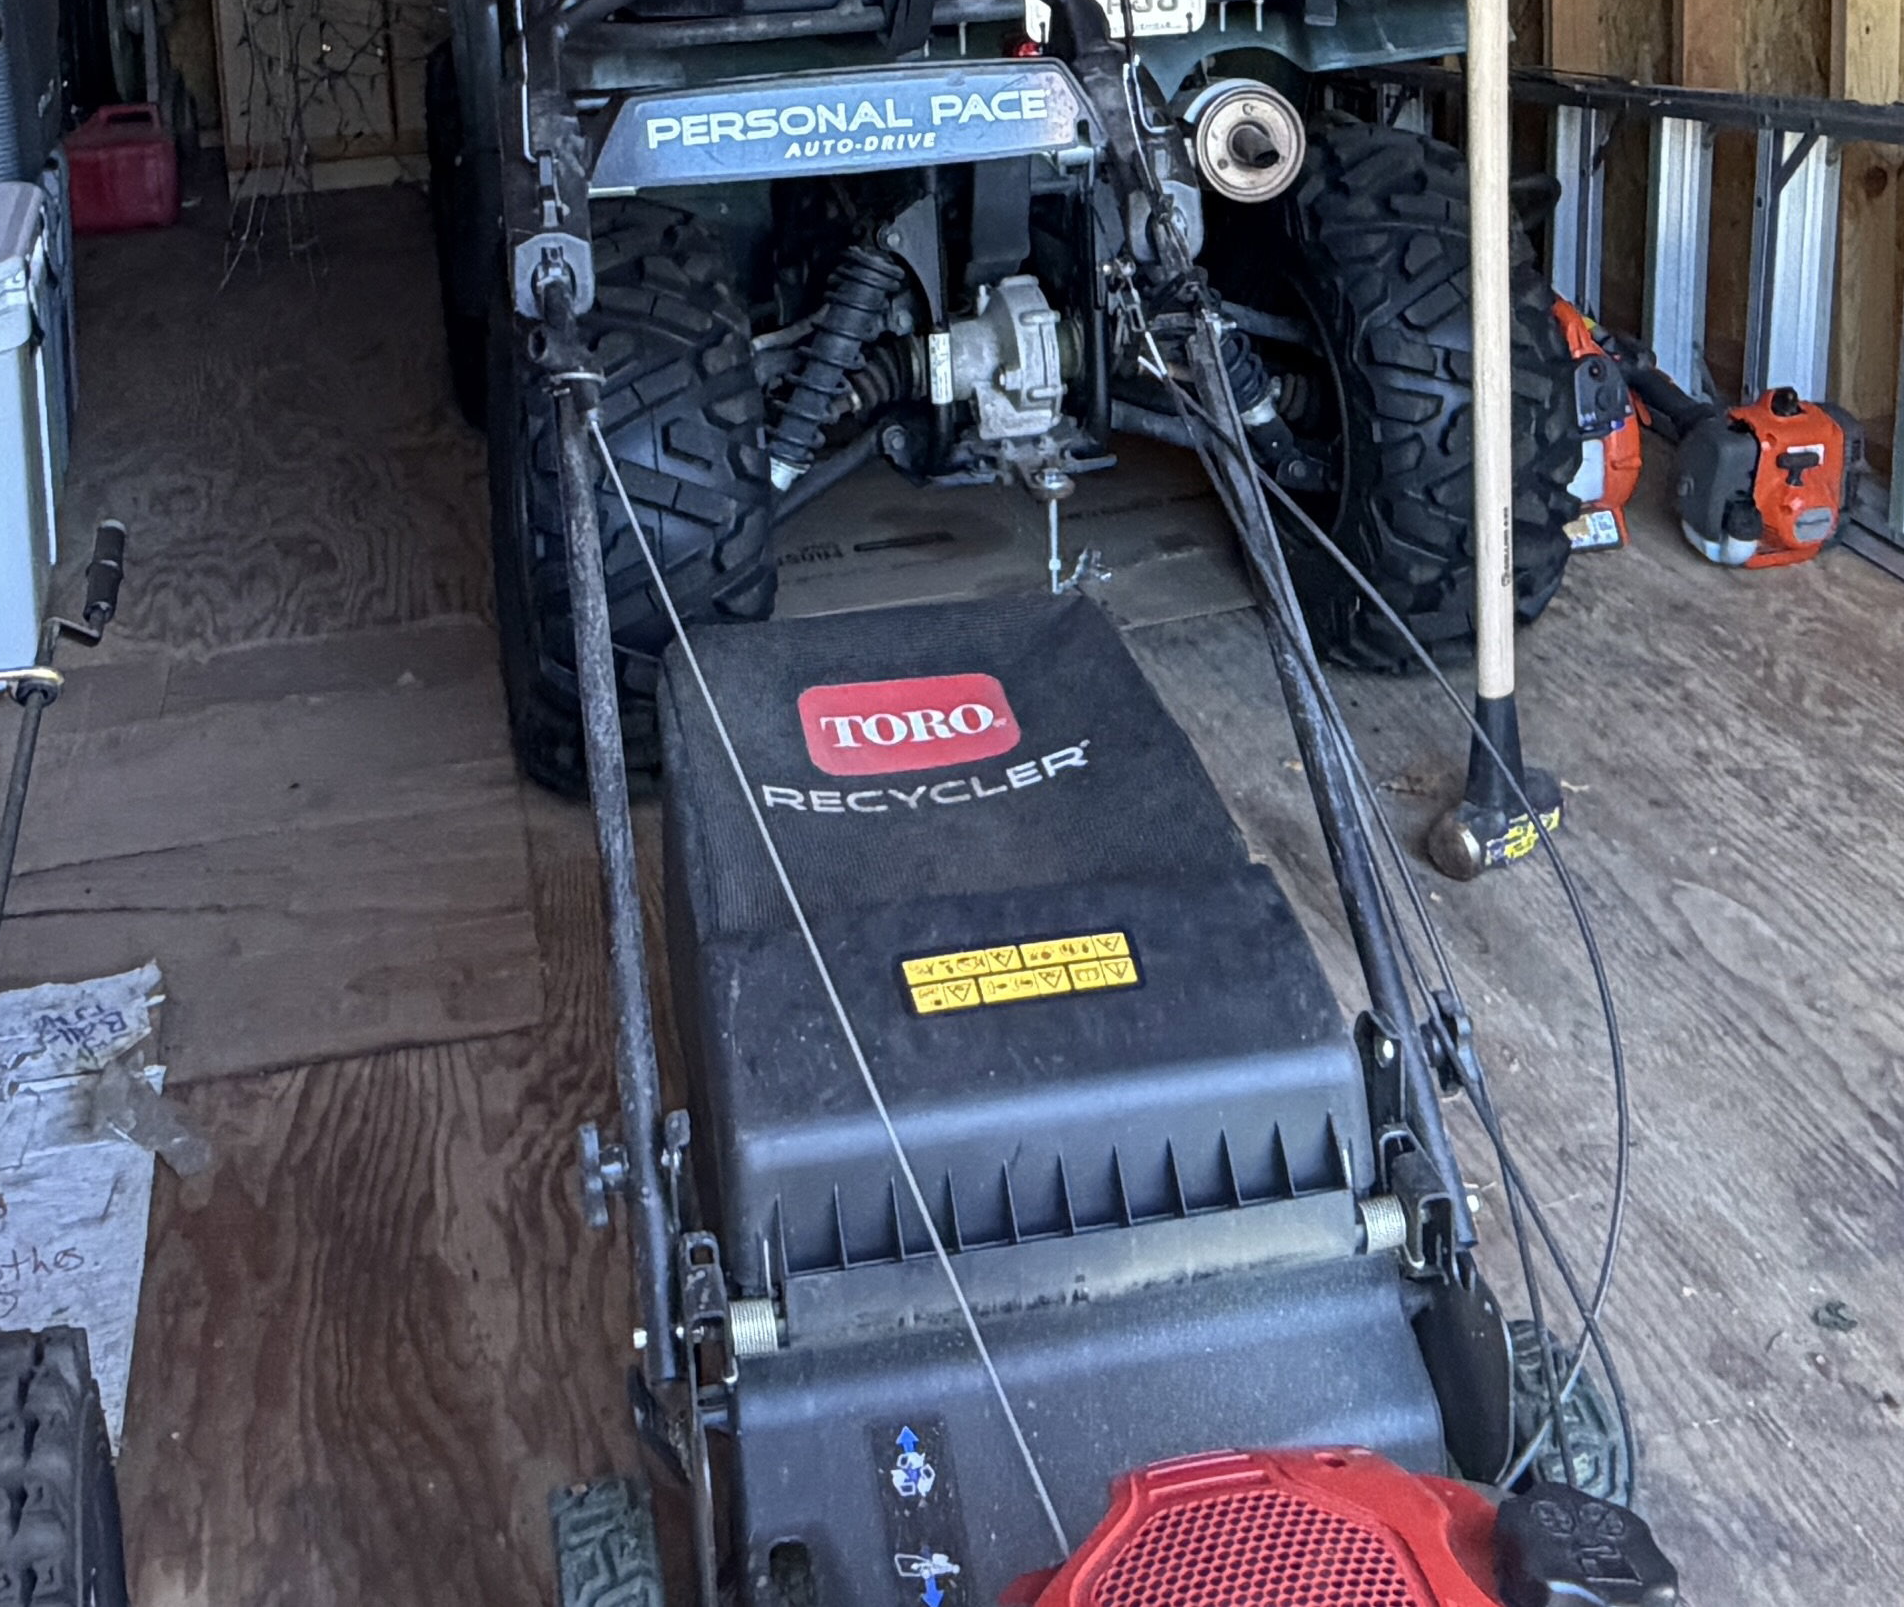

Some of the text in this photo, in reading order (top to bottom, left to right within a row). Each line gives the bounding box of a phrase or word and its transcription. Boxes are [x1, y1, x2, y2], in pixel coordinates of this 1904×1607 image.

[647, 88, 1049, 150] PERSONAL PACE
[785, 131, 937, 160] AUTO-DRIVE
[820, 702, 995, 749] TORO
[763, 745, 1088, 813] RECYCLER
